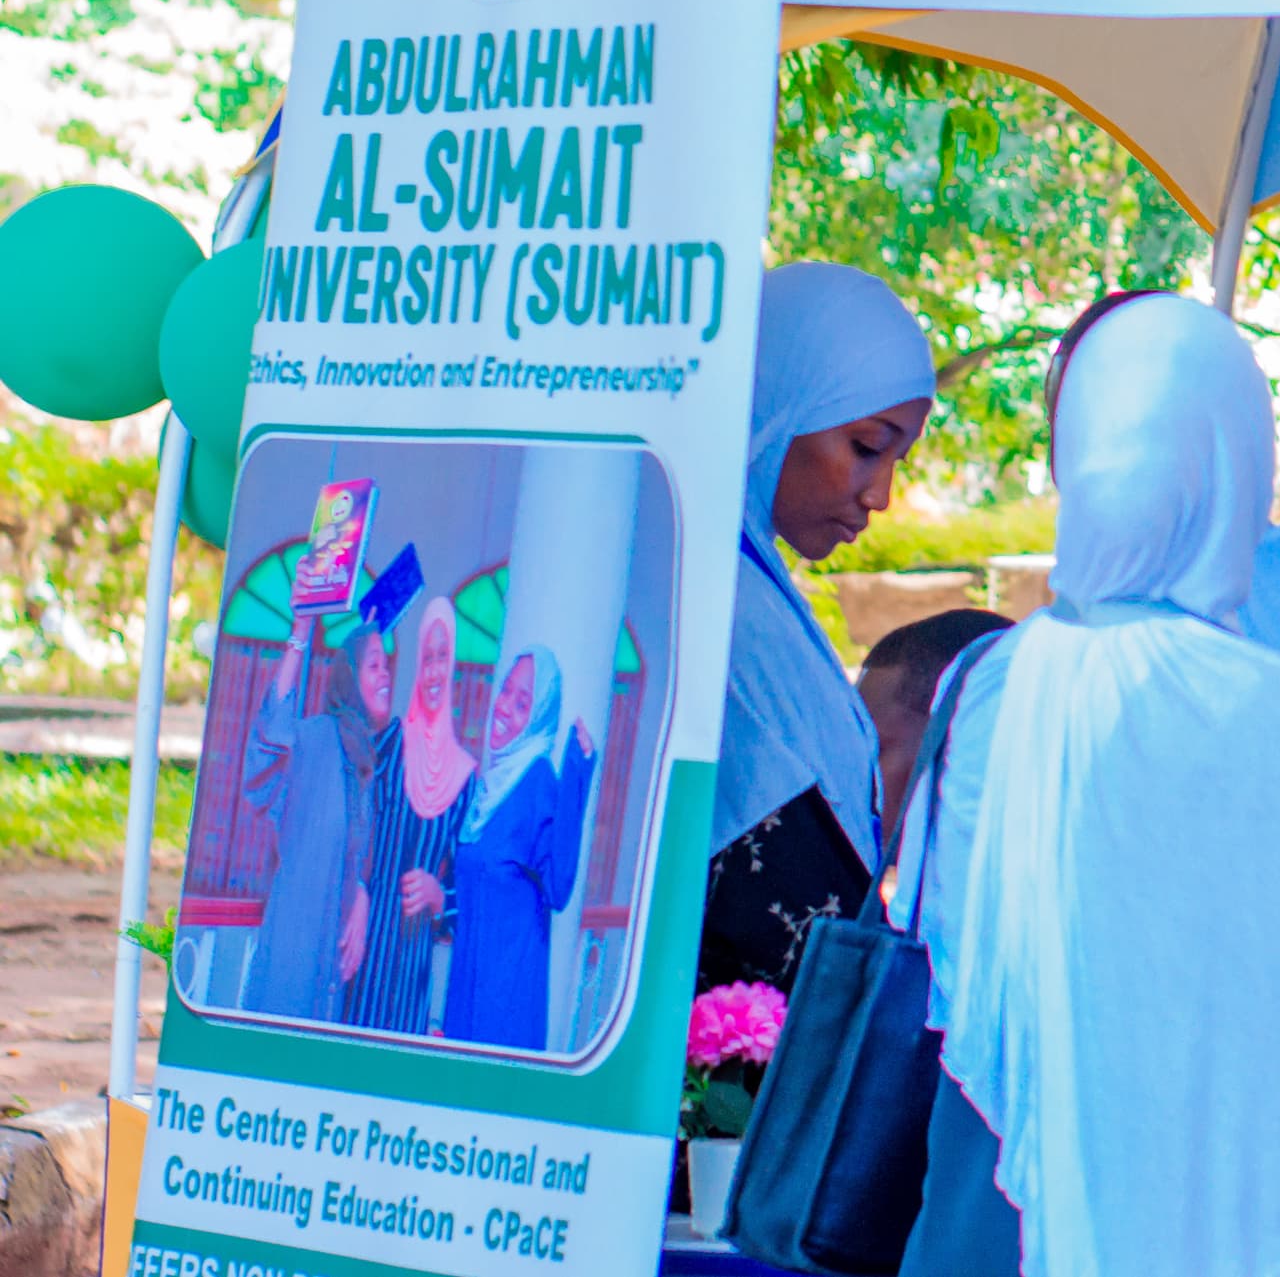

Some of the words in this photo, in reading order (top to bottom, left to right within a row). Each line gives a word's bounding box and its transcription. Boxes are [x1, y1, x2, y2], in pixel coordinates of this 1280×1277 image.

[322, 23, 656, 116] ABDULRAHMAN
[315, 123, 643, 232] AL-SUMAIT
[259, 242, 497, 324] NIVERSITY
[505, 241, 726, 342] (SUMAIT)
[315, 352, 436, 388] Innovation
[440, 355, 473, 388] and
[155, 1087, 206, 1135] The
[214, 1096, 308, 1149] Centre
[315, 1111, 359, 1157] For
[364, 1121, 536, 1186] Professional
[541, 1152, 591, 1195] and
[163, 1155, 312, 1228] Continuing
[320, 1180, 456, 1243] Education
[483, 1212, 568, 1263] CPaCE
